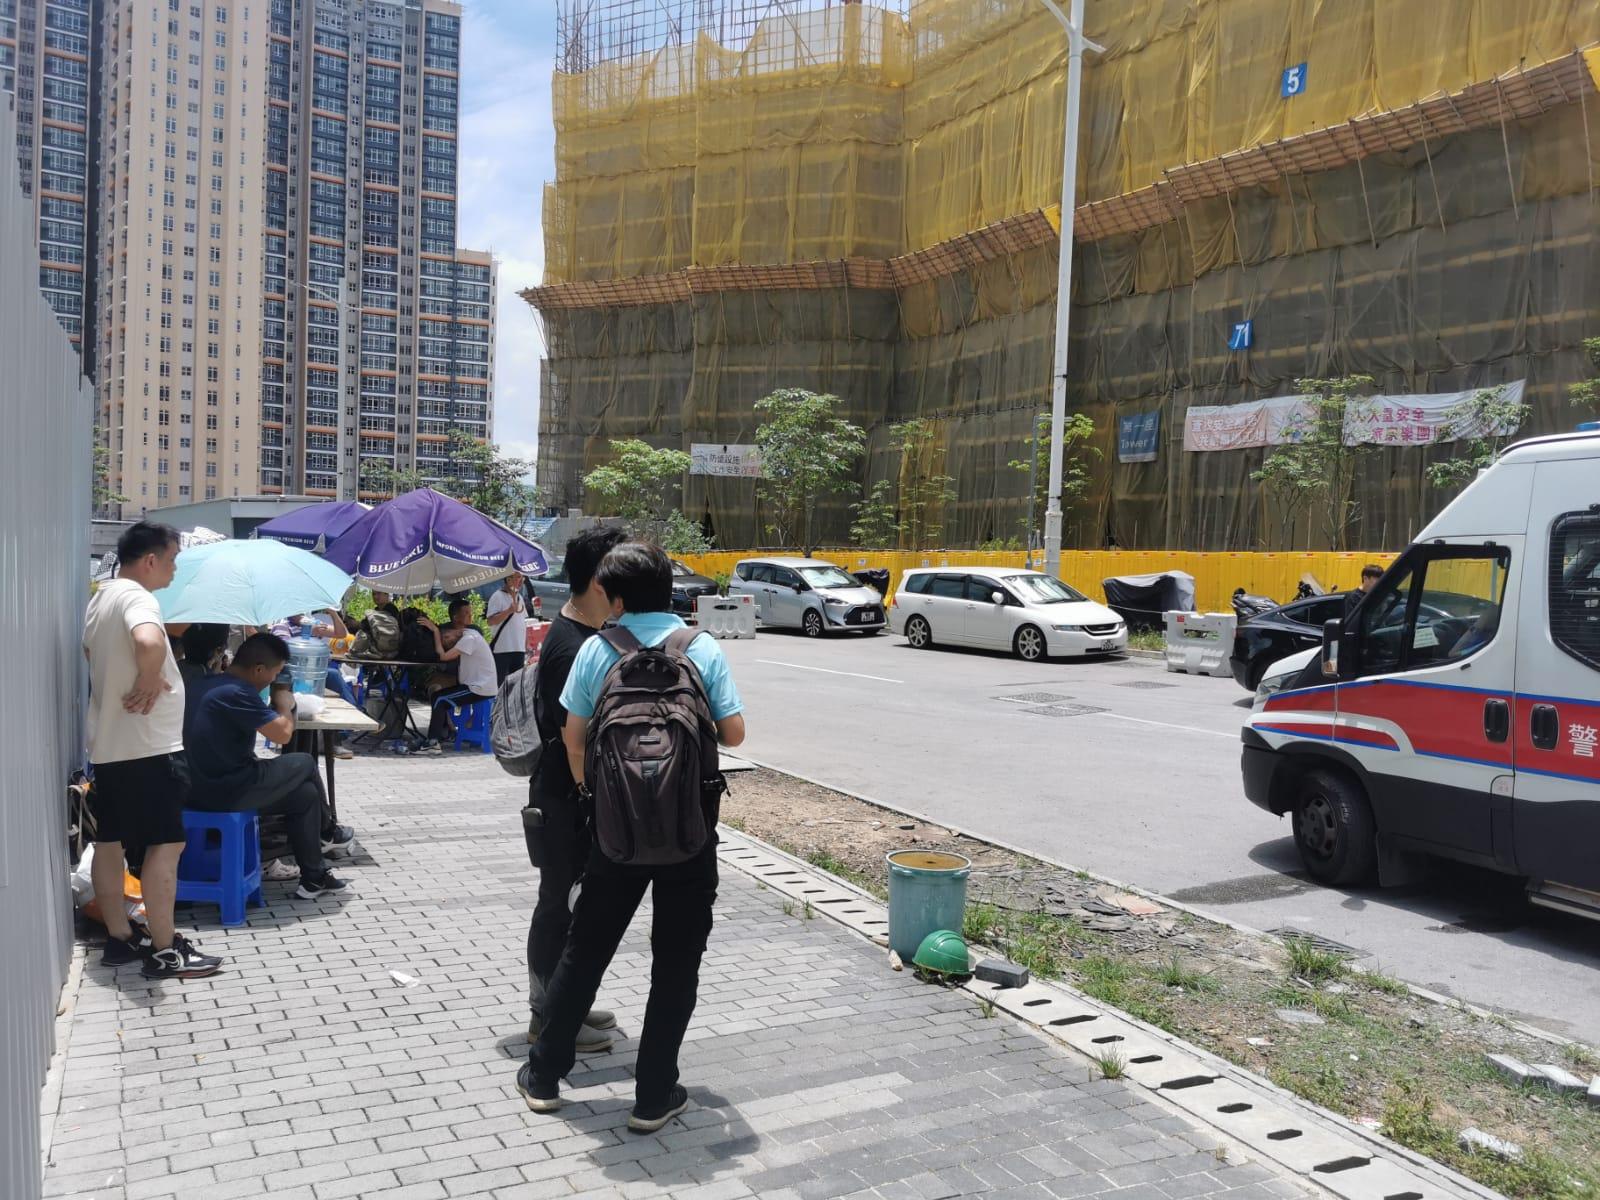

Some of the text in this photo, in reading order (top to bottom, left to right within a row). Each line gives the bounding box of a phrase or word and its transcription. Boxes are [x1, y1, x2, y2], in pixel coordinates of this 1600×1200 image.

[1287, 67, 1300, 94] 5
[1234, 322, 1250, 348] 71
[1120, 439, 1148, 449] Tower
[368, 560, 400, 574] BLUE
[1568, 723, 1599, 758] 警
